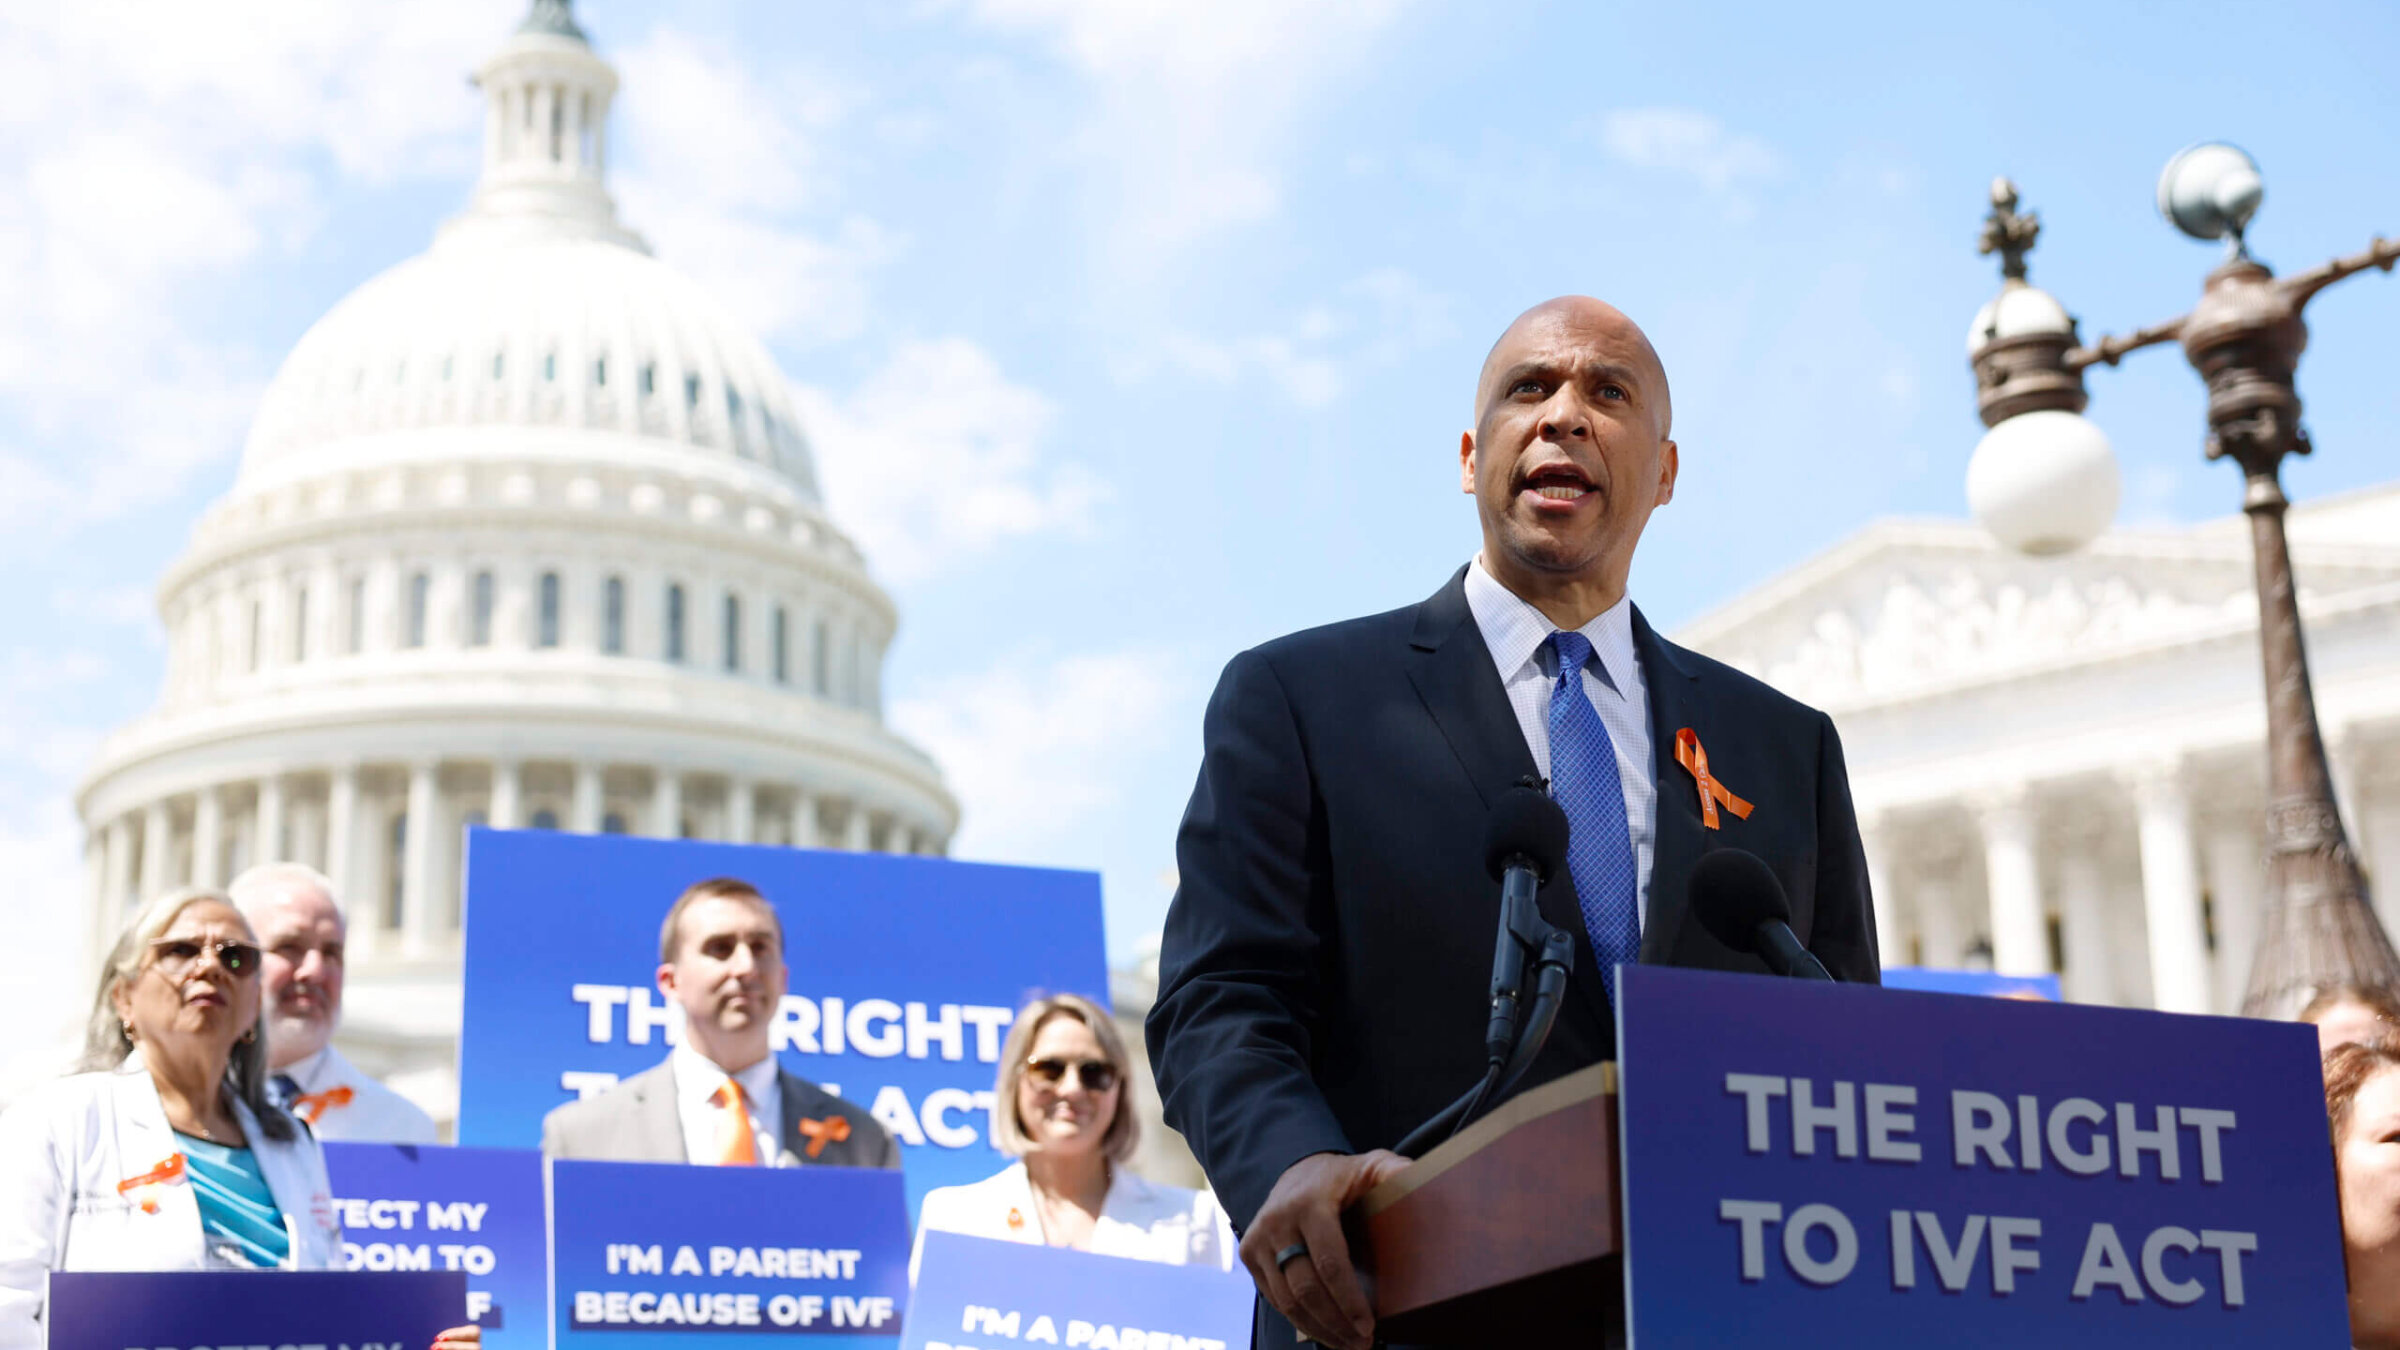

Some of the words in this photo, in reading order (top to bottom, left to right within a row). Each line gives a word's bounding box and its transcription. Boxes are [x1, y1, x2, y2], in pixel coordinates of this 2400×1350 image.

[572, 983, 684, 1046] TH
[768, 994, 1014, 1063] RIGHT
[1726, 1072, 1922, 1162] THE
[1952, 1089, 2236, 1182] RIGHT
[426, 1201, 489, 1232] MY
[437, 1244, 497, 1276] TO
[606, 1243, 663, 1276] I'M
[670, 1245, 703, 1277] A
[709, 1245, 862, 1280] PARENT
[1720, 1199, 1859, 1285] TO
[1890, 1209, 2042, 1293] IVF
[2072, 1222, 2258, 1306] ACT
[574, 1291, 762, 1326] BECAUSE
[767, 1294, 823, 1327] OF
[831, 1295, 894, 1329] IVF
[962, 1304, 1021, 1339] I'M
[1024, 1314, 1059, 1345] A
